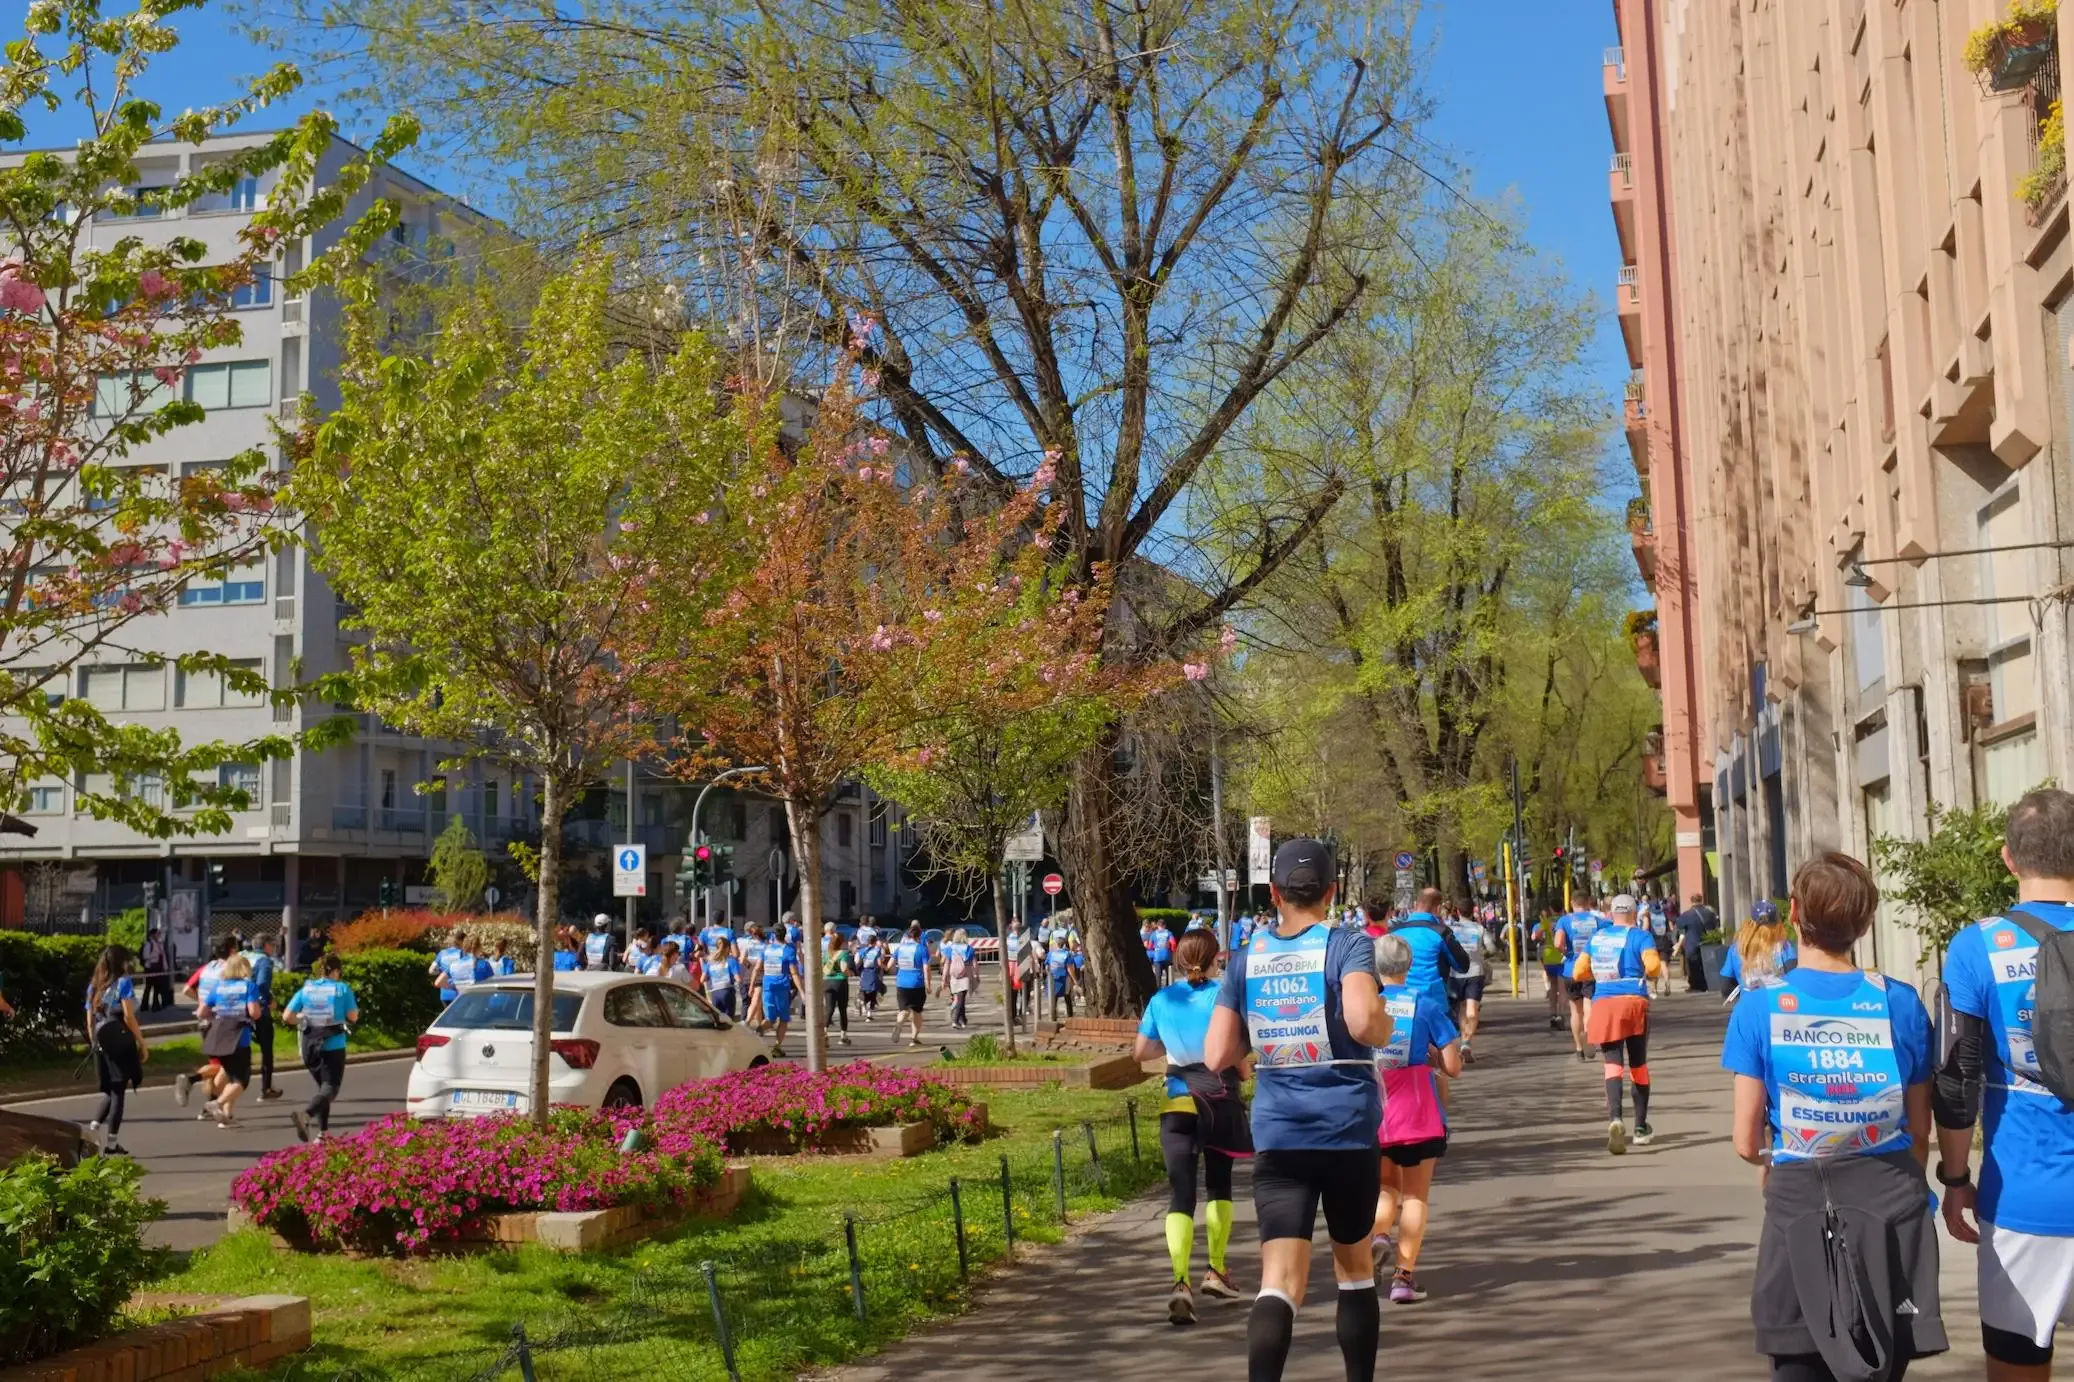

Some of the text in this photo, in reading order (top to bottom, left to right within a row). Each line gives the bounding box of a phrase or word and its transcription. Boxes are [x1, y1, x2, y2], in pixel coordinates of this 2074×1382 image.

[1253, 960, 1317, 976] BANCO BPM
[2005, 962, 2037, 978] BAN
[1261, 976, 1309, 995] 41062
[1257, 1025, 1320, 1038] ESSELUNGA
[1783, 1029, 1881, 1045] BANCO BPM
[1807, 1049, 1864, 1069] 1884
[1788, 1071, 1888, 1084] Stramilano
[1792, 1107, 1889, 1124] ESSELUNGA
